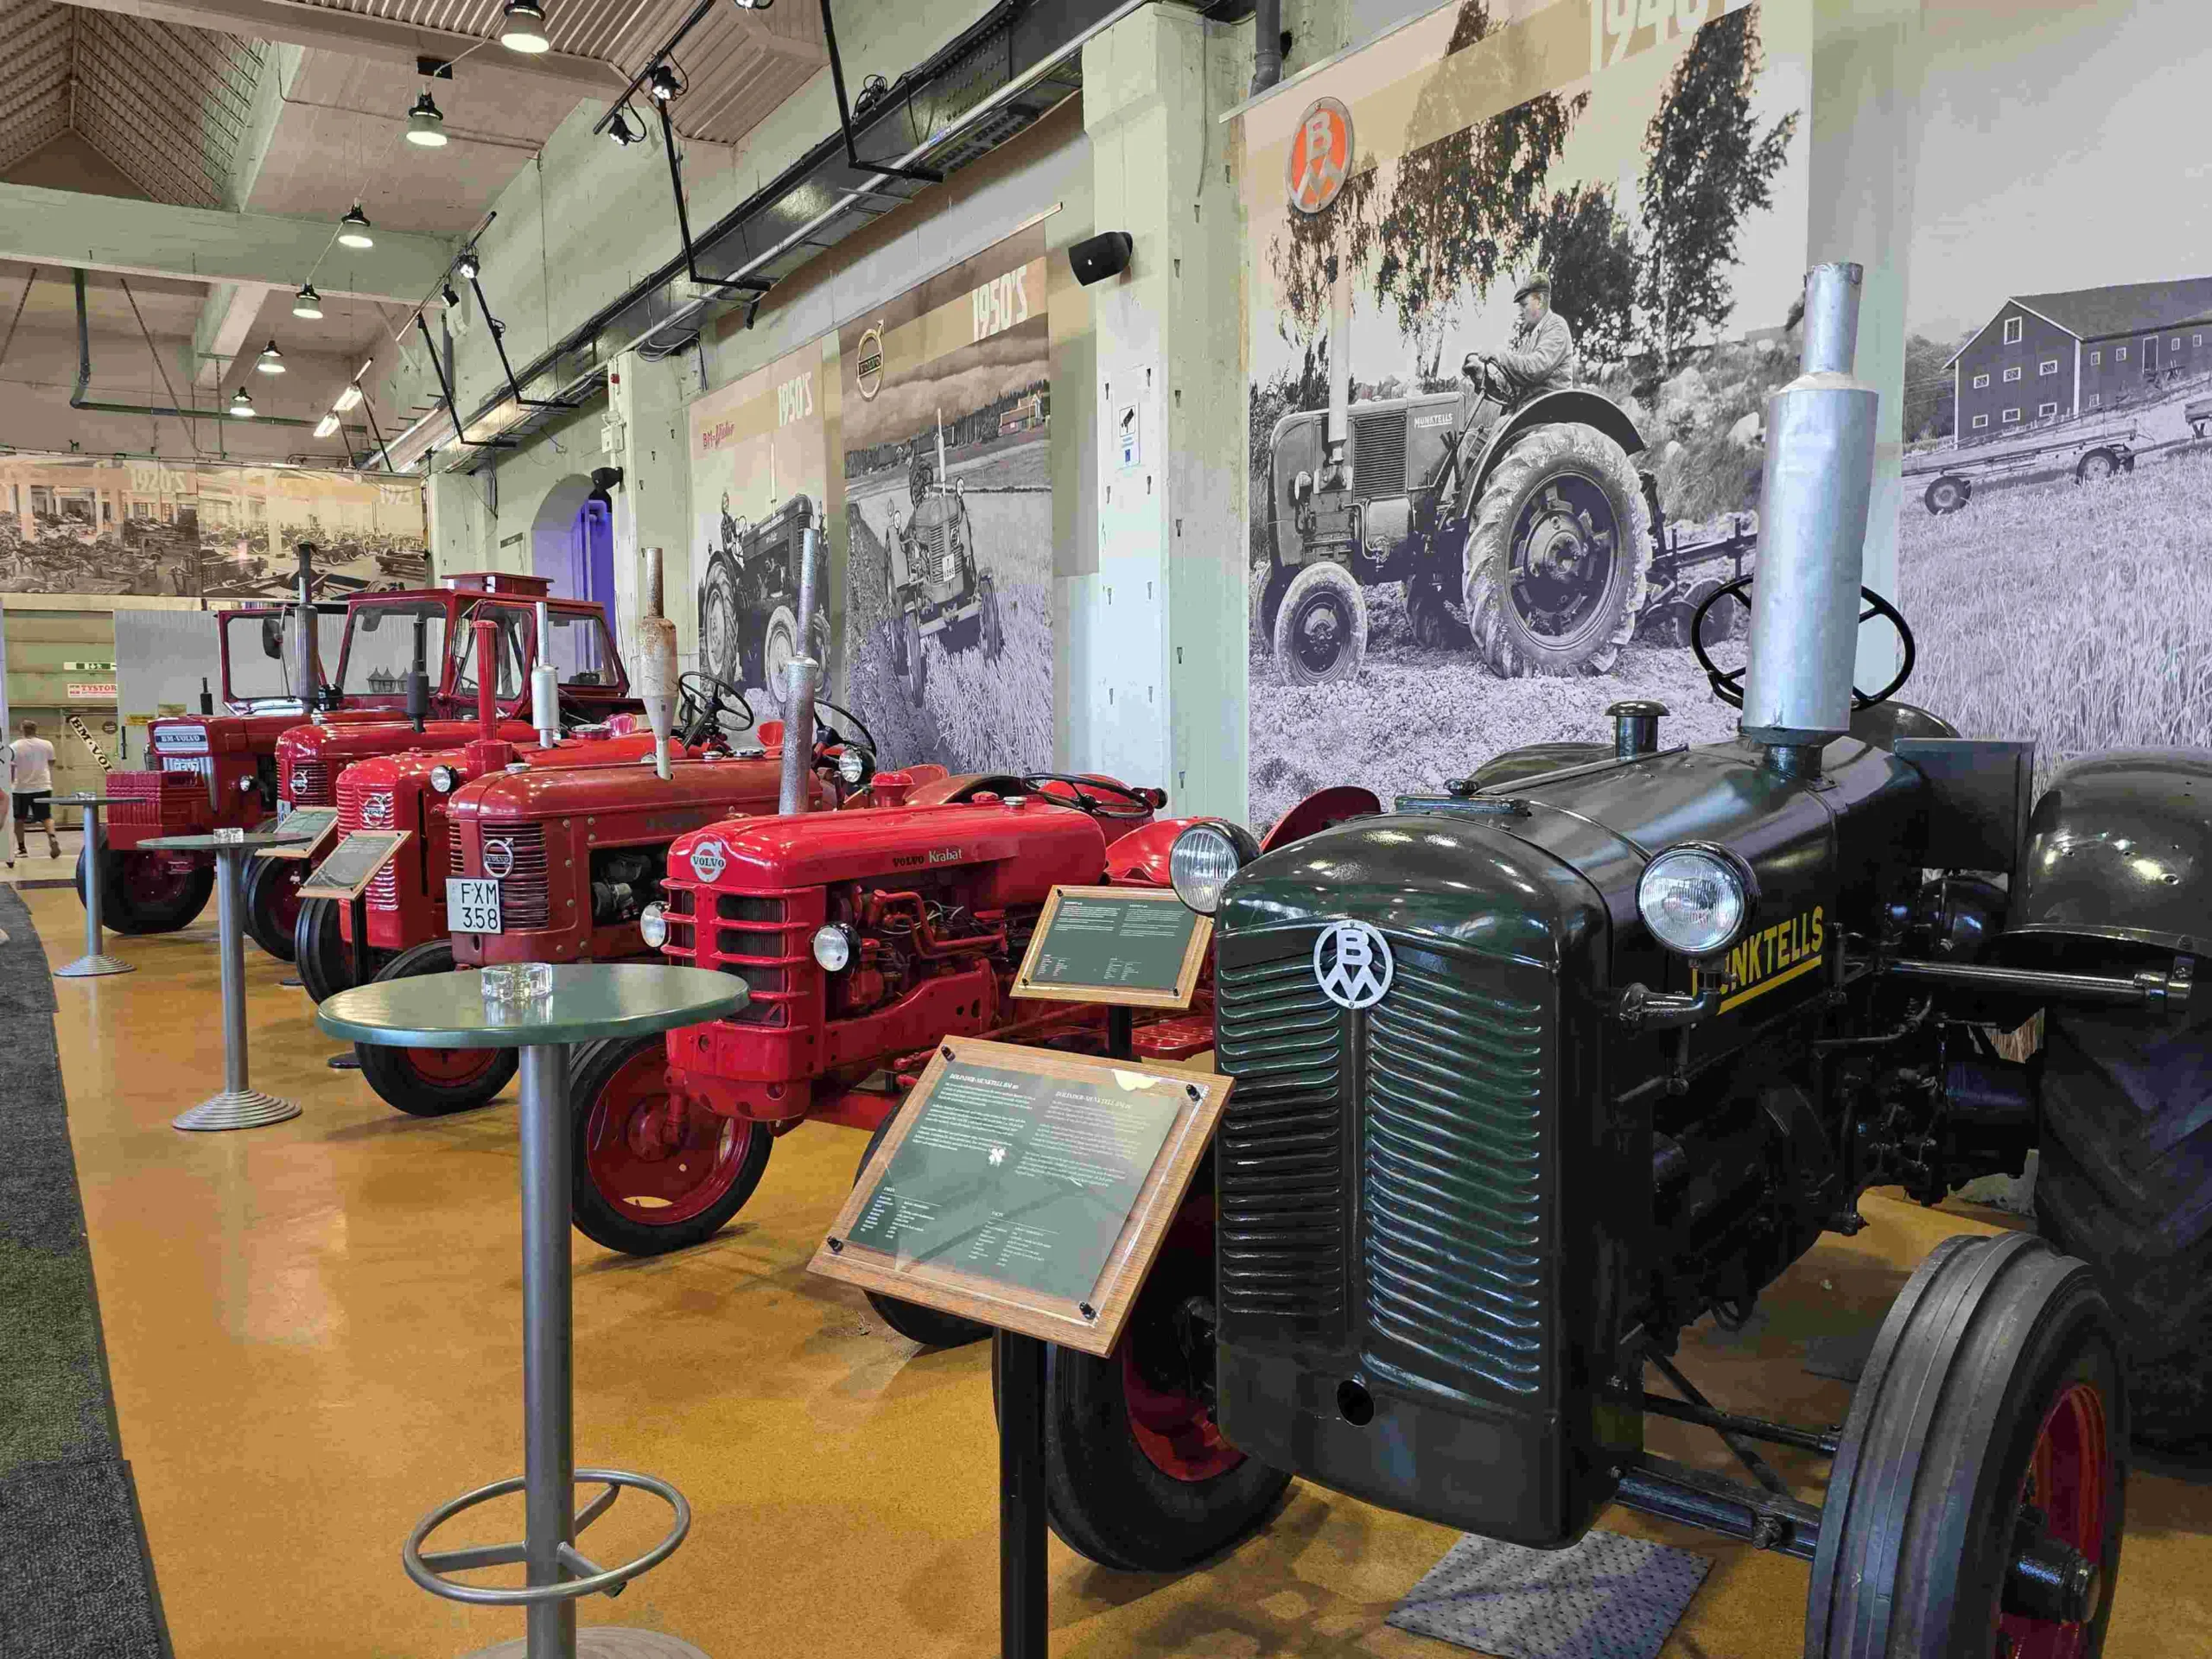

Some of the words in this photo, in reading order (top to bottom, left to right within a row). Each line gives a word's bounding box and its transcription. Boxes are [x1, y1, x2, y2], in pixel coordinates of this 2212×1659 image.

[972, 266, 1028, 343] 1950'S
[778, 372, 813, 427] 1950'S
[486, 855, 510, 863] VOLVO
[692, 855, 726, 868] VOLVO
[893, 855, 925, 868] VOLVO
[929, 848, 963, 863] Krabat
[461, 882, 498, 906] FXM
[462, 906, 499, 930] 358
[1692, 906, 1824, 997] NKTELLS
